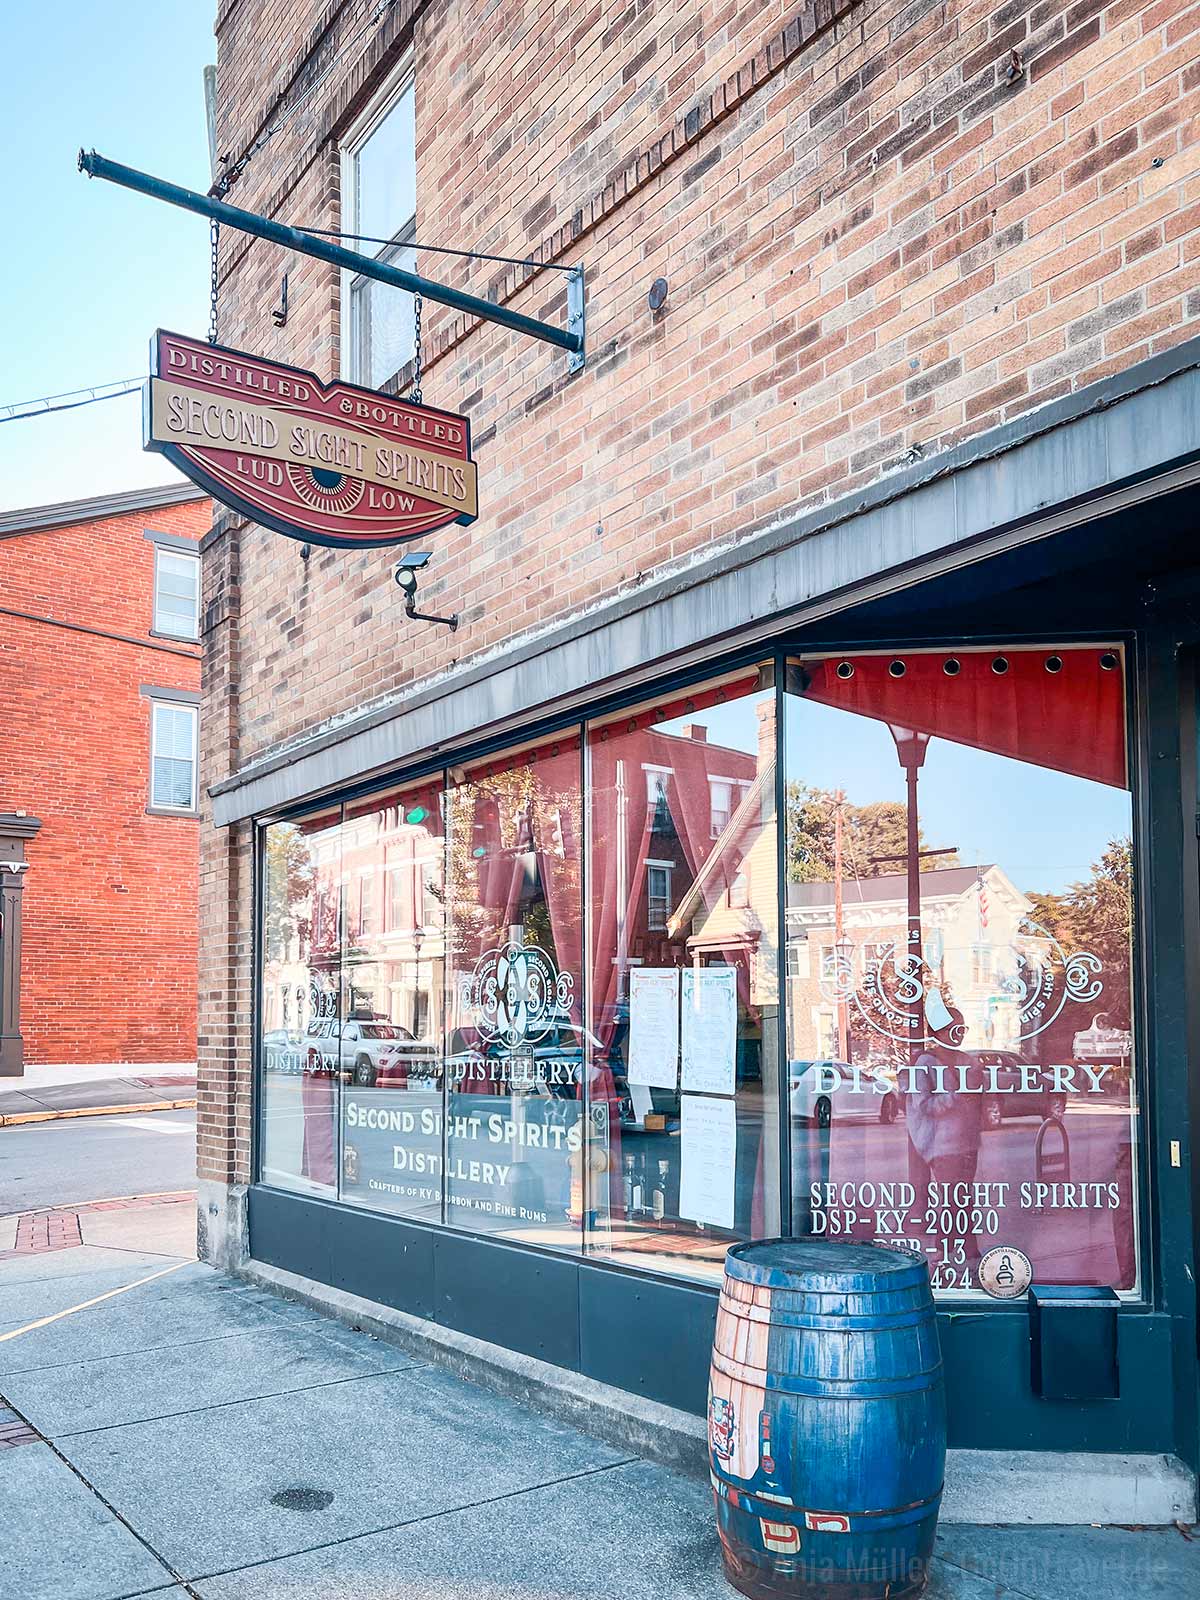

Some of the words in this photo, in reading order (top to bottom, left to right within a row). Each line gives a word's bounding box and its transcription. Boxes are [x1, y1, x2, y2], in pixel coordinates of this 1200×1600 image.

[168, 349, 310, 402] DISTILLED
[166, 392, 280, 449] SECOND
[289, 425, 368, 473] SIGHT
[375, 447, 467, 501] SPIRITS
[236, 456, 284, 487] LUD
[369, 486, 416, 513] LOW
[266, 1053, 338, 1072] DISTILLERY
[453, 1060, 581, 1085] DISTILLERY
[809, 1064, 1113, 1094] DISTILLERY
[347, 1102, 415, 1132] SECOND
[487, 1114, 583, 1152] SPIRITS
[419, 1187, 433, 1201] KY
[810, 1182, 916, 1209] SECOND
[927, 1182, 1009, 1209] SIGHT
[1020, 1182, 1121, 1209] SPIRITS
[810, 1208, 1000, 1236] DSP-KY-20020
